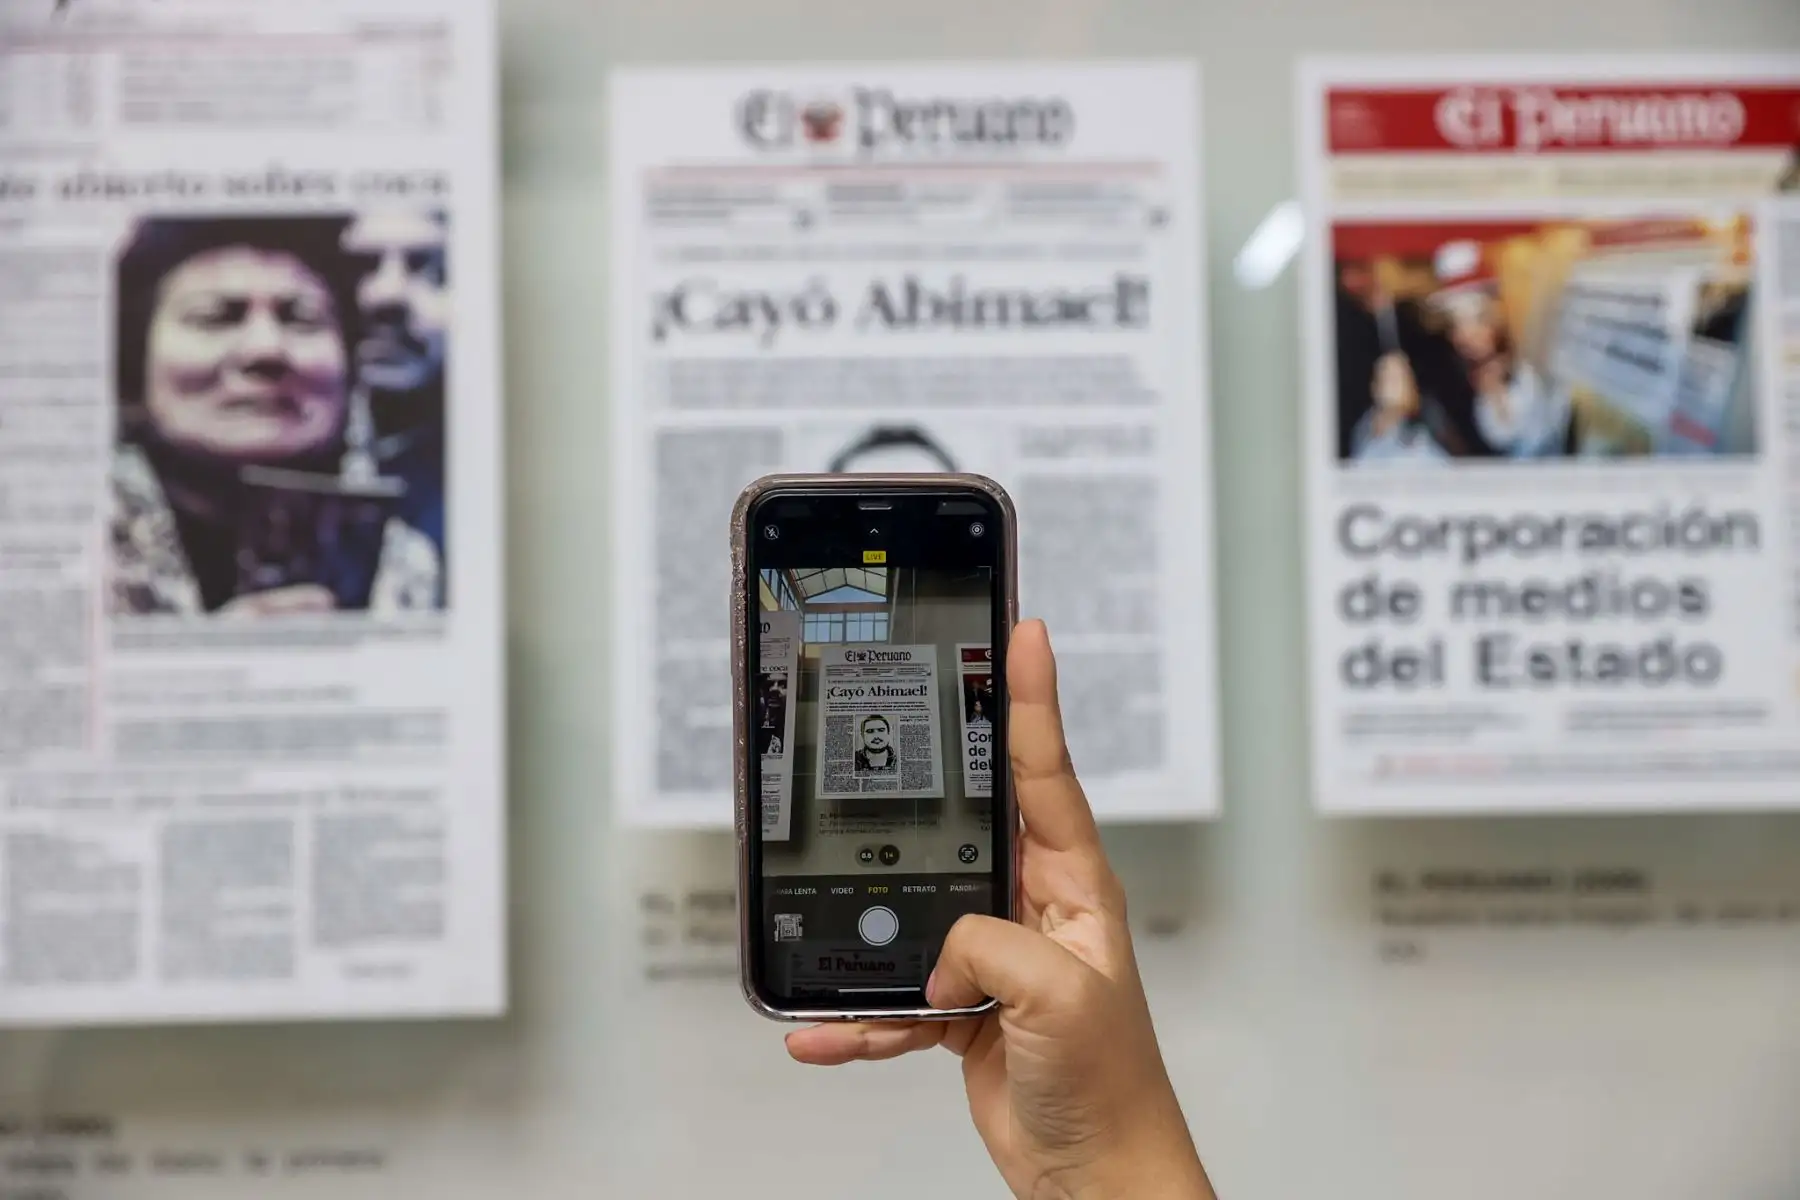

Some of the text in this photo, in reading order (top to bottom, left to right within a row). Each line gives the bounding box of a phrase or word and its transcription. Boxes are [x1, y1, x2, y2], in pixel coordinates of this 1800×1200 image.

[853, 87, 1073, 156] Peruano
[1513, 86, 1745, 153] Peruano
[652, 273, 1149, 346] ¡Cayó Abimael!
[1337, 500, 1760, 563] Corporación
[1338, 570, 1709, 622] de medios
[845, 649, 911, 663] El Peruano
[1339, 636, 1722, 688] del Estado
[827, 685, 928, 700] ¡Cayó Abimael!
[968, 745, 987, 756] de
[970, 759, 992, 771] del
[794, 887, 817, 895] LENTA
[868, 886, 888, 894] FOTO
[902, 885, 937, 893] RETRATO
